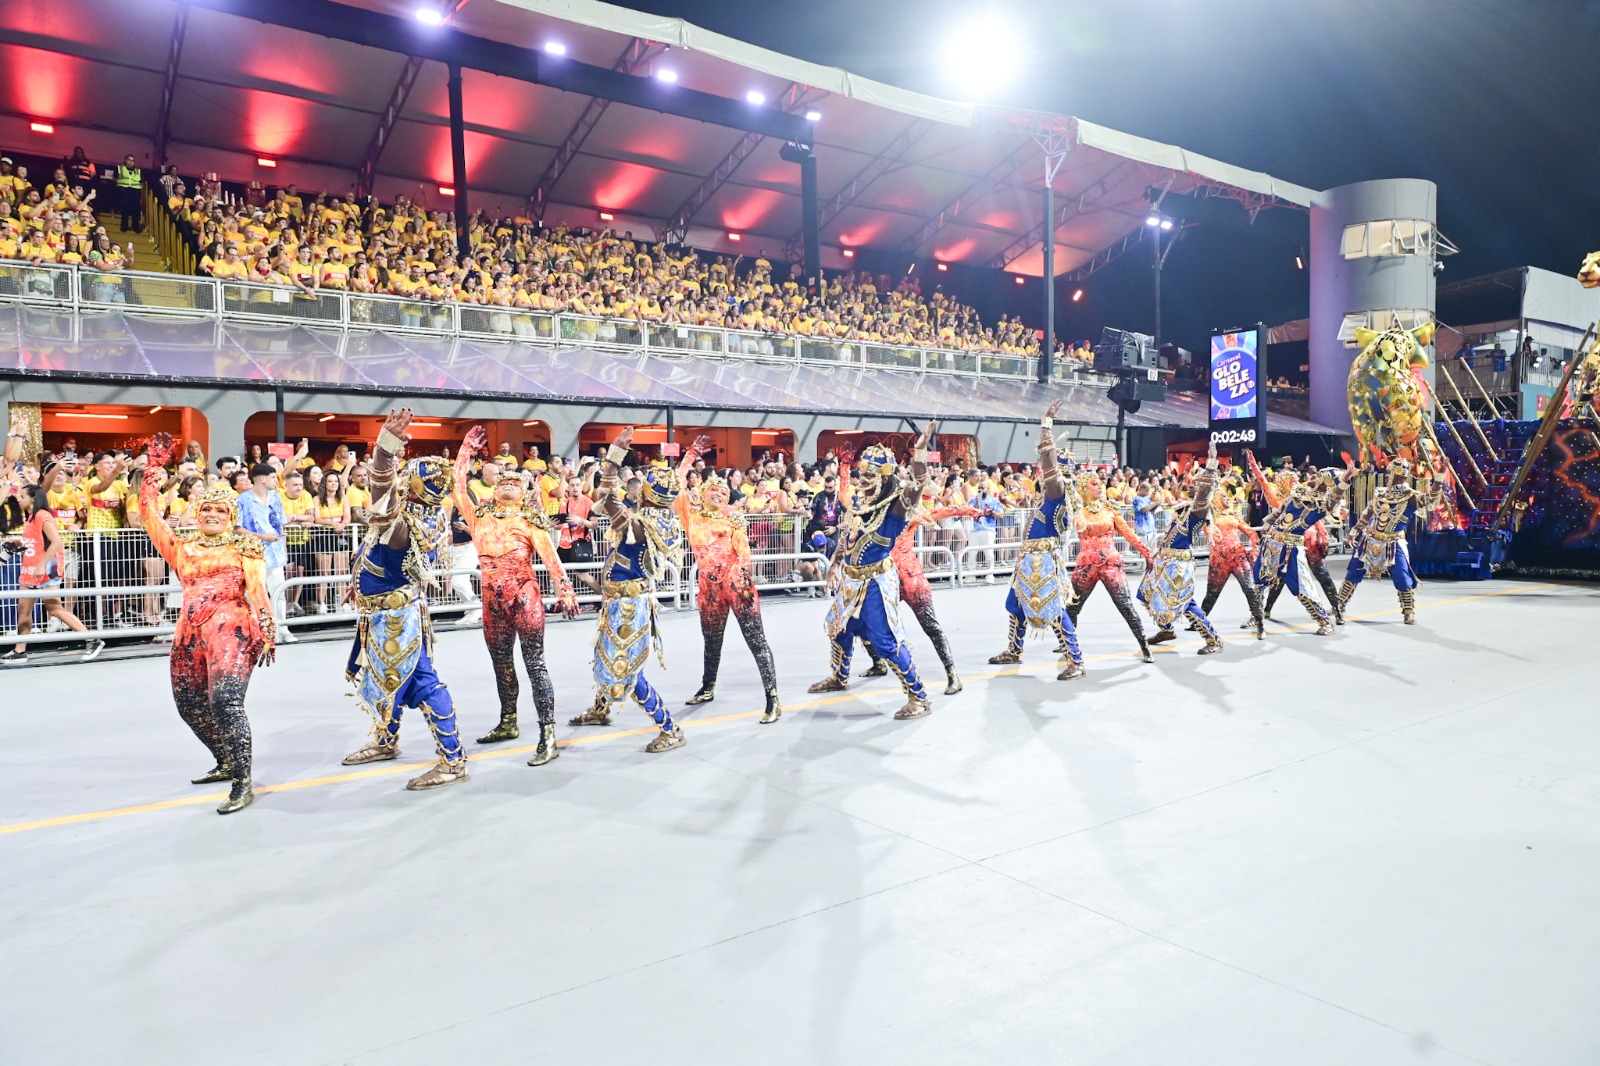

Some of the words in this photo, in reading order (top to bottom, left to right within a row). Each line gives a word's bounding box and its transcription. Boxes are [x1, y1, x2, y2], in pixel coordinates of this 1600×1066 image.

[1216, 352, 1242, 367] Carnaval
[1213, 361, 1241, 380] GLO
[1218, 369, 1250, 391] BELE
[1230, 384, 1249, 399] ZA
[1211, 429, 1256, 443] 0:02:49
